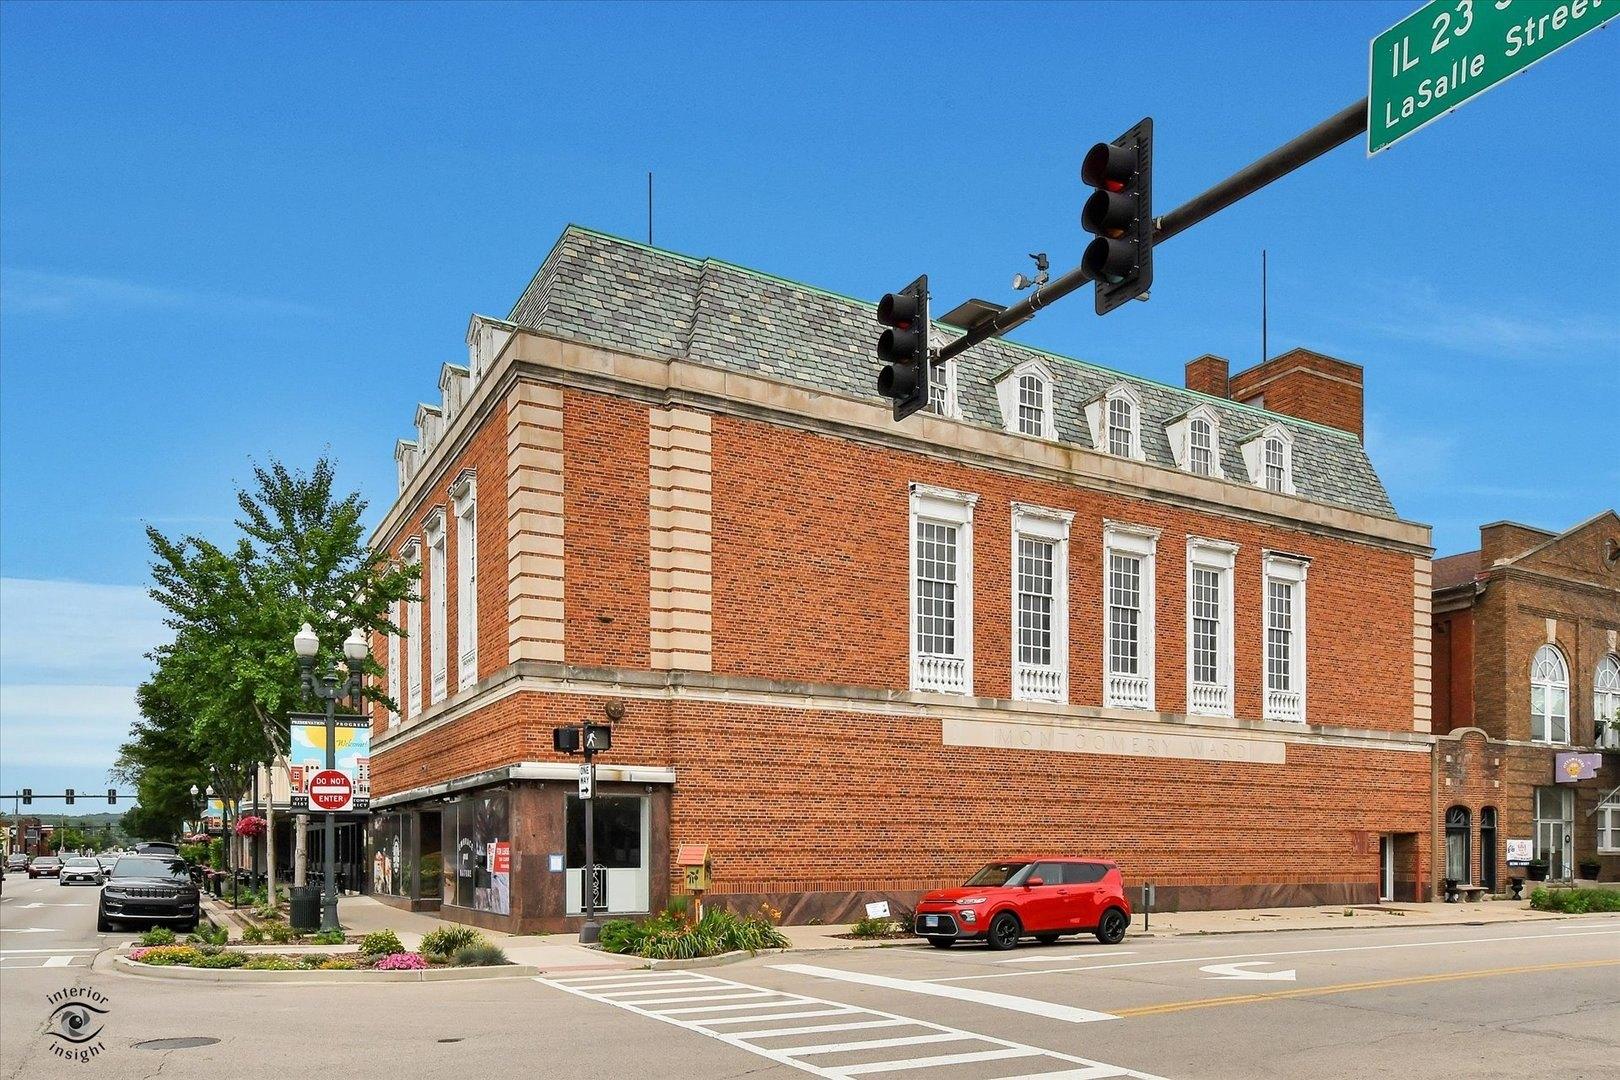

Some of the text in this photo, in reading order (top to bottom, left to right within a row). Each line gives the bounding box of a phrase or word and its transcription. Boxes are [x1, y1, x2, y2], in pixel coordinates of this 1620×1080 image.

[1392, 0, 1473, 77] IL 23
[1386, 0, 1602, 128] LaSalle Stree
[992, 727, 1247, 758] MONTGOMERY WARD
[580, 766, 590, 775] ONE
[316, 777, 346, 785] DO NOT
[580, 776, 590, 784] WAY
[318, 795, 344, 803] ENTER
